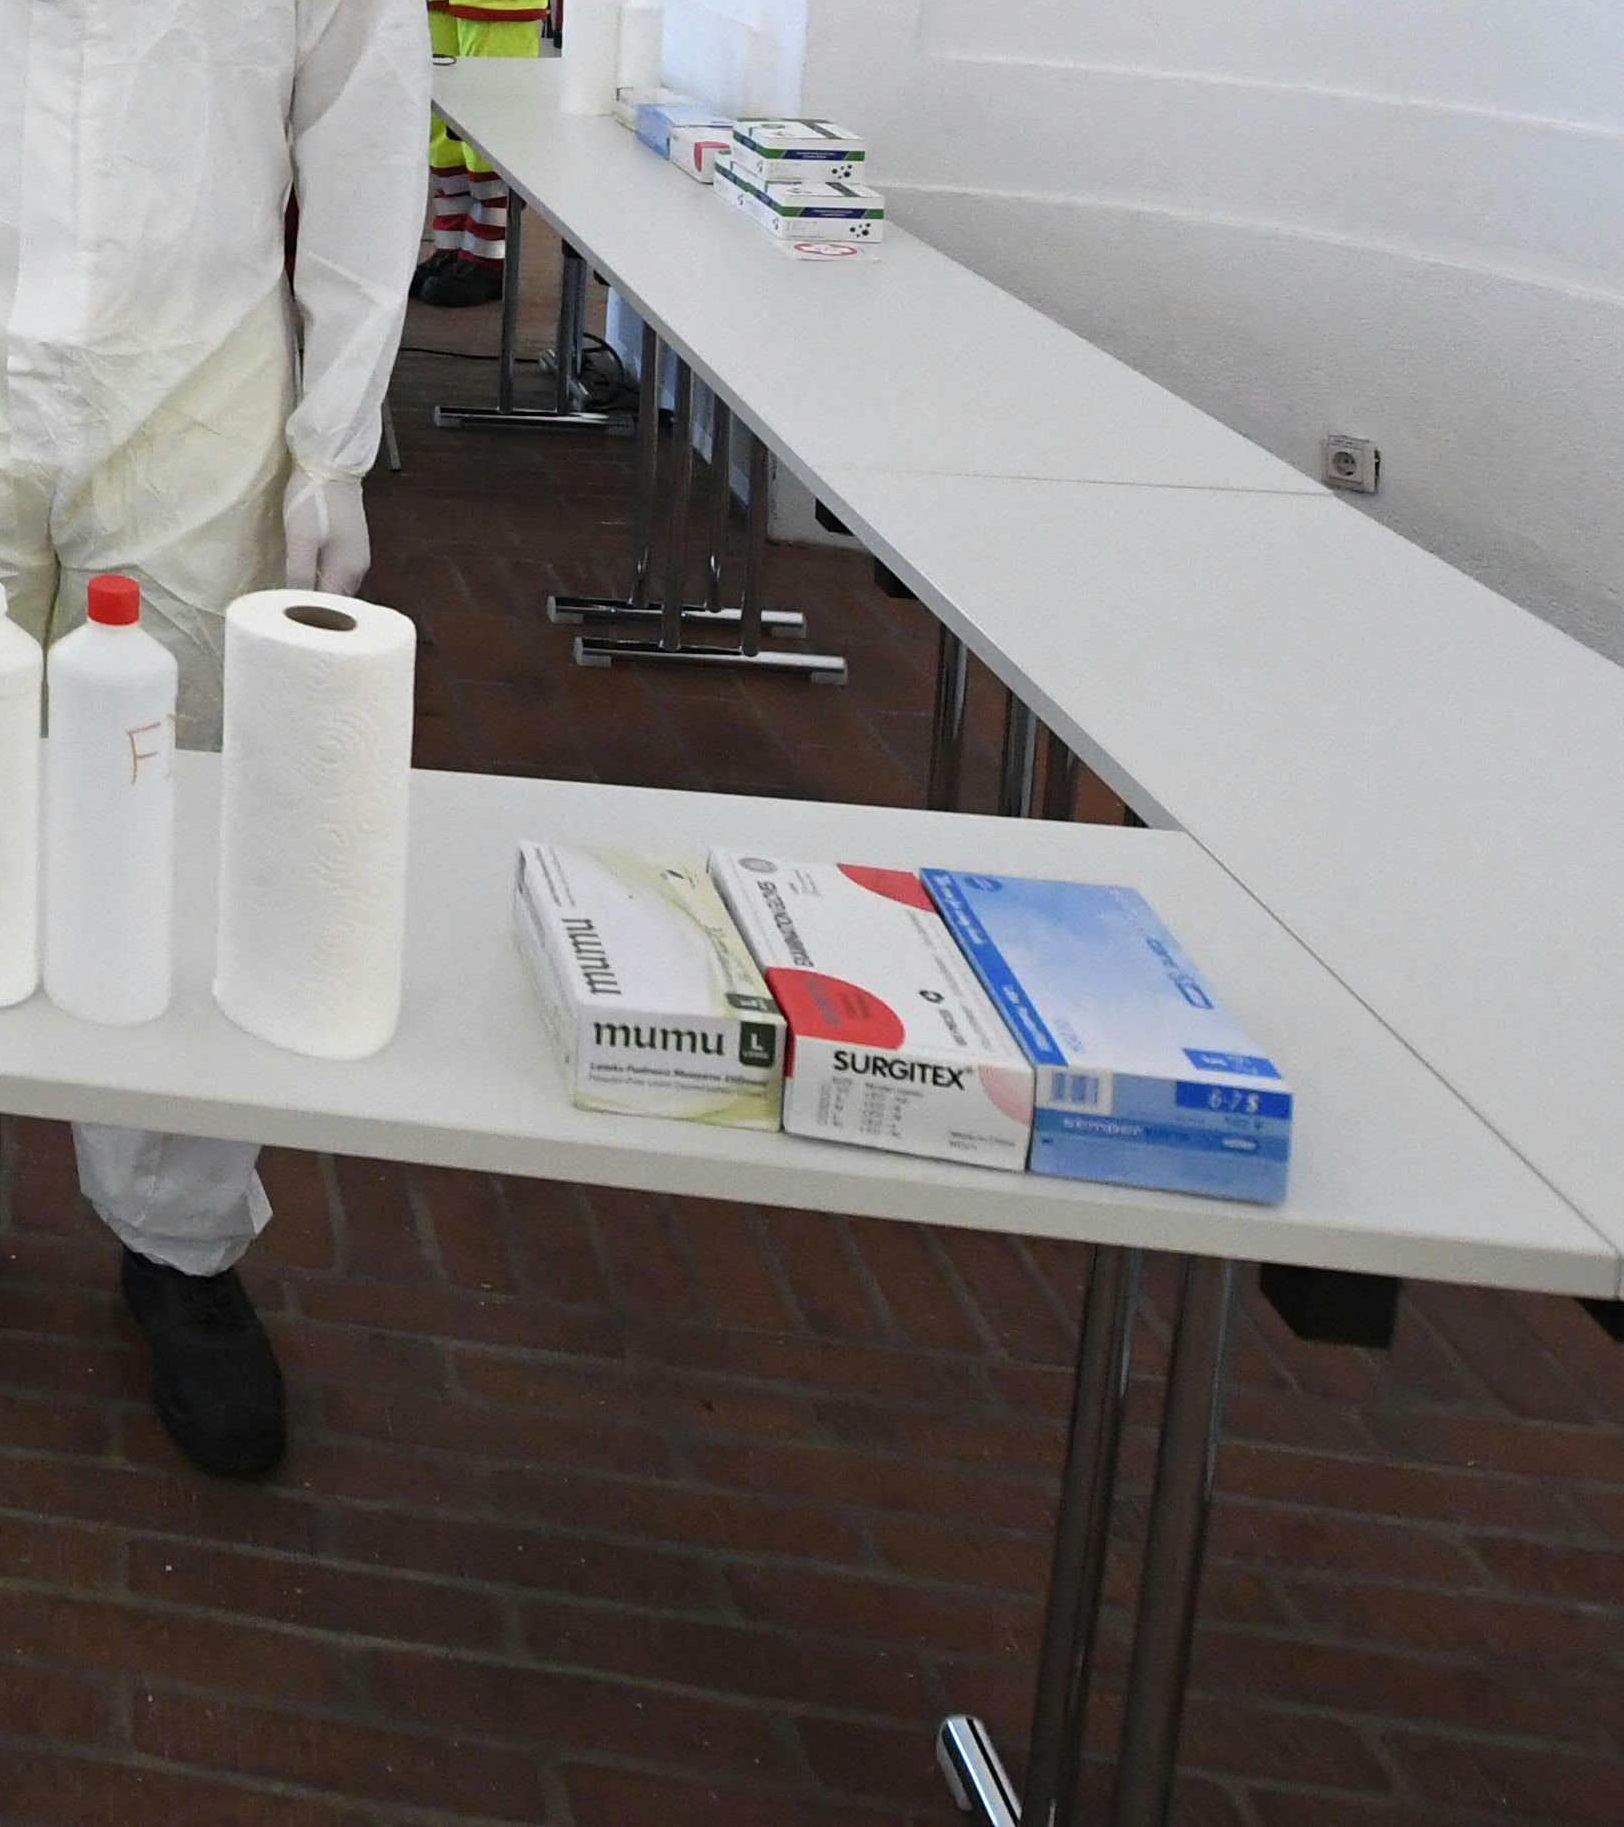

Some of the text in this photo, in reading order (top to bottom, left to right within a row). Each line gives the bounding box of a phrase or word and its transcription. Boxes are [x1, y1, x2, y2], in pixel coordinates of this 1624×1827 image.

[127, 714, 177, 785] F
[561, 917, 622, 995] mumu
[593, 1022, 763, 1056] mumu L
[833, 1049, 965, 1091] SURGITEX
